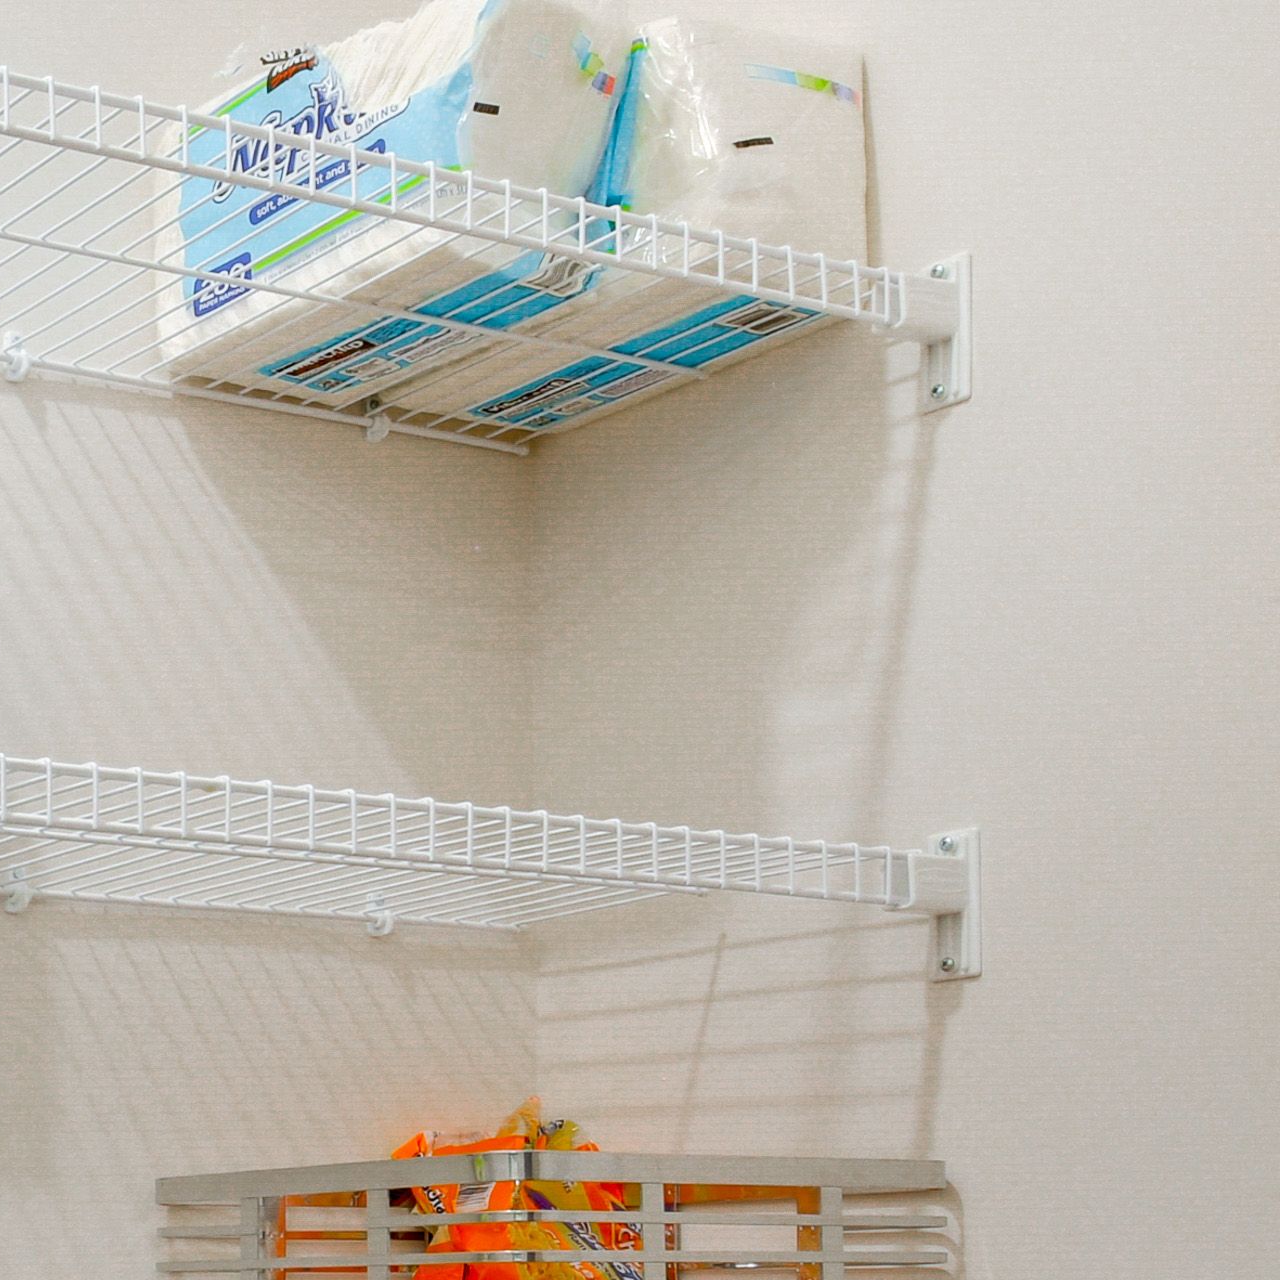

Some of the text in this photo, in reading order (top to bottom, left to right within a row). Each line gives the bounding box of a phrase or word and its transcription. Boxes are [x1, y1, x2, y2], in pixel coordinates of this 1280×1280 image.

[356, 104, 399, 133] DINING
[255, 163, 346, 219] soft, and
